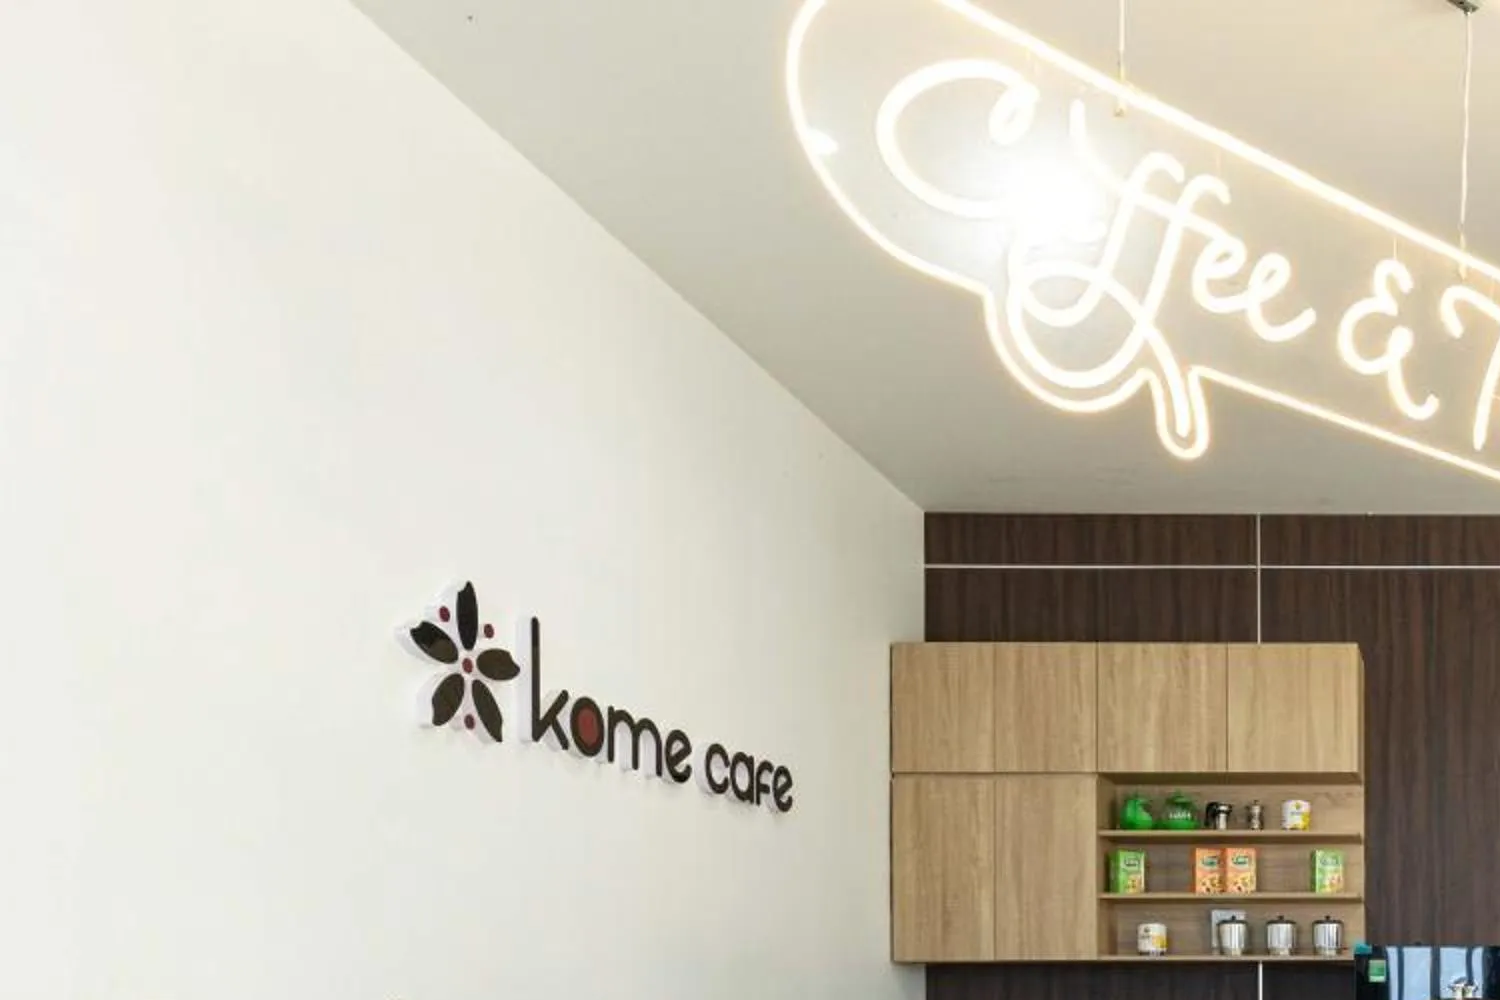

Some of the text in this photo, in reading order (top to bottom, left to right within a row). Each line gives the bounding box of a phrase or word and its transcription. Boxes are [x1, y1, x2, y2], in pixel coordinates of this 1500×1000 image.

[1337, 260, 1438, 420] &
[529, 616, 794, 812] kome cafe
